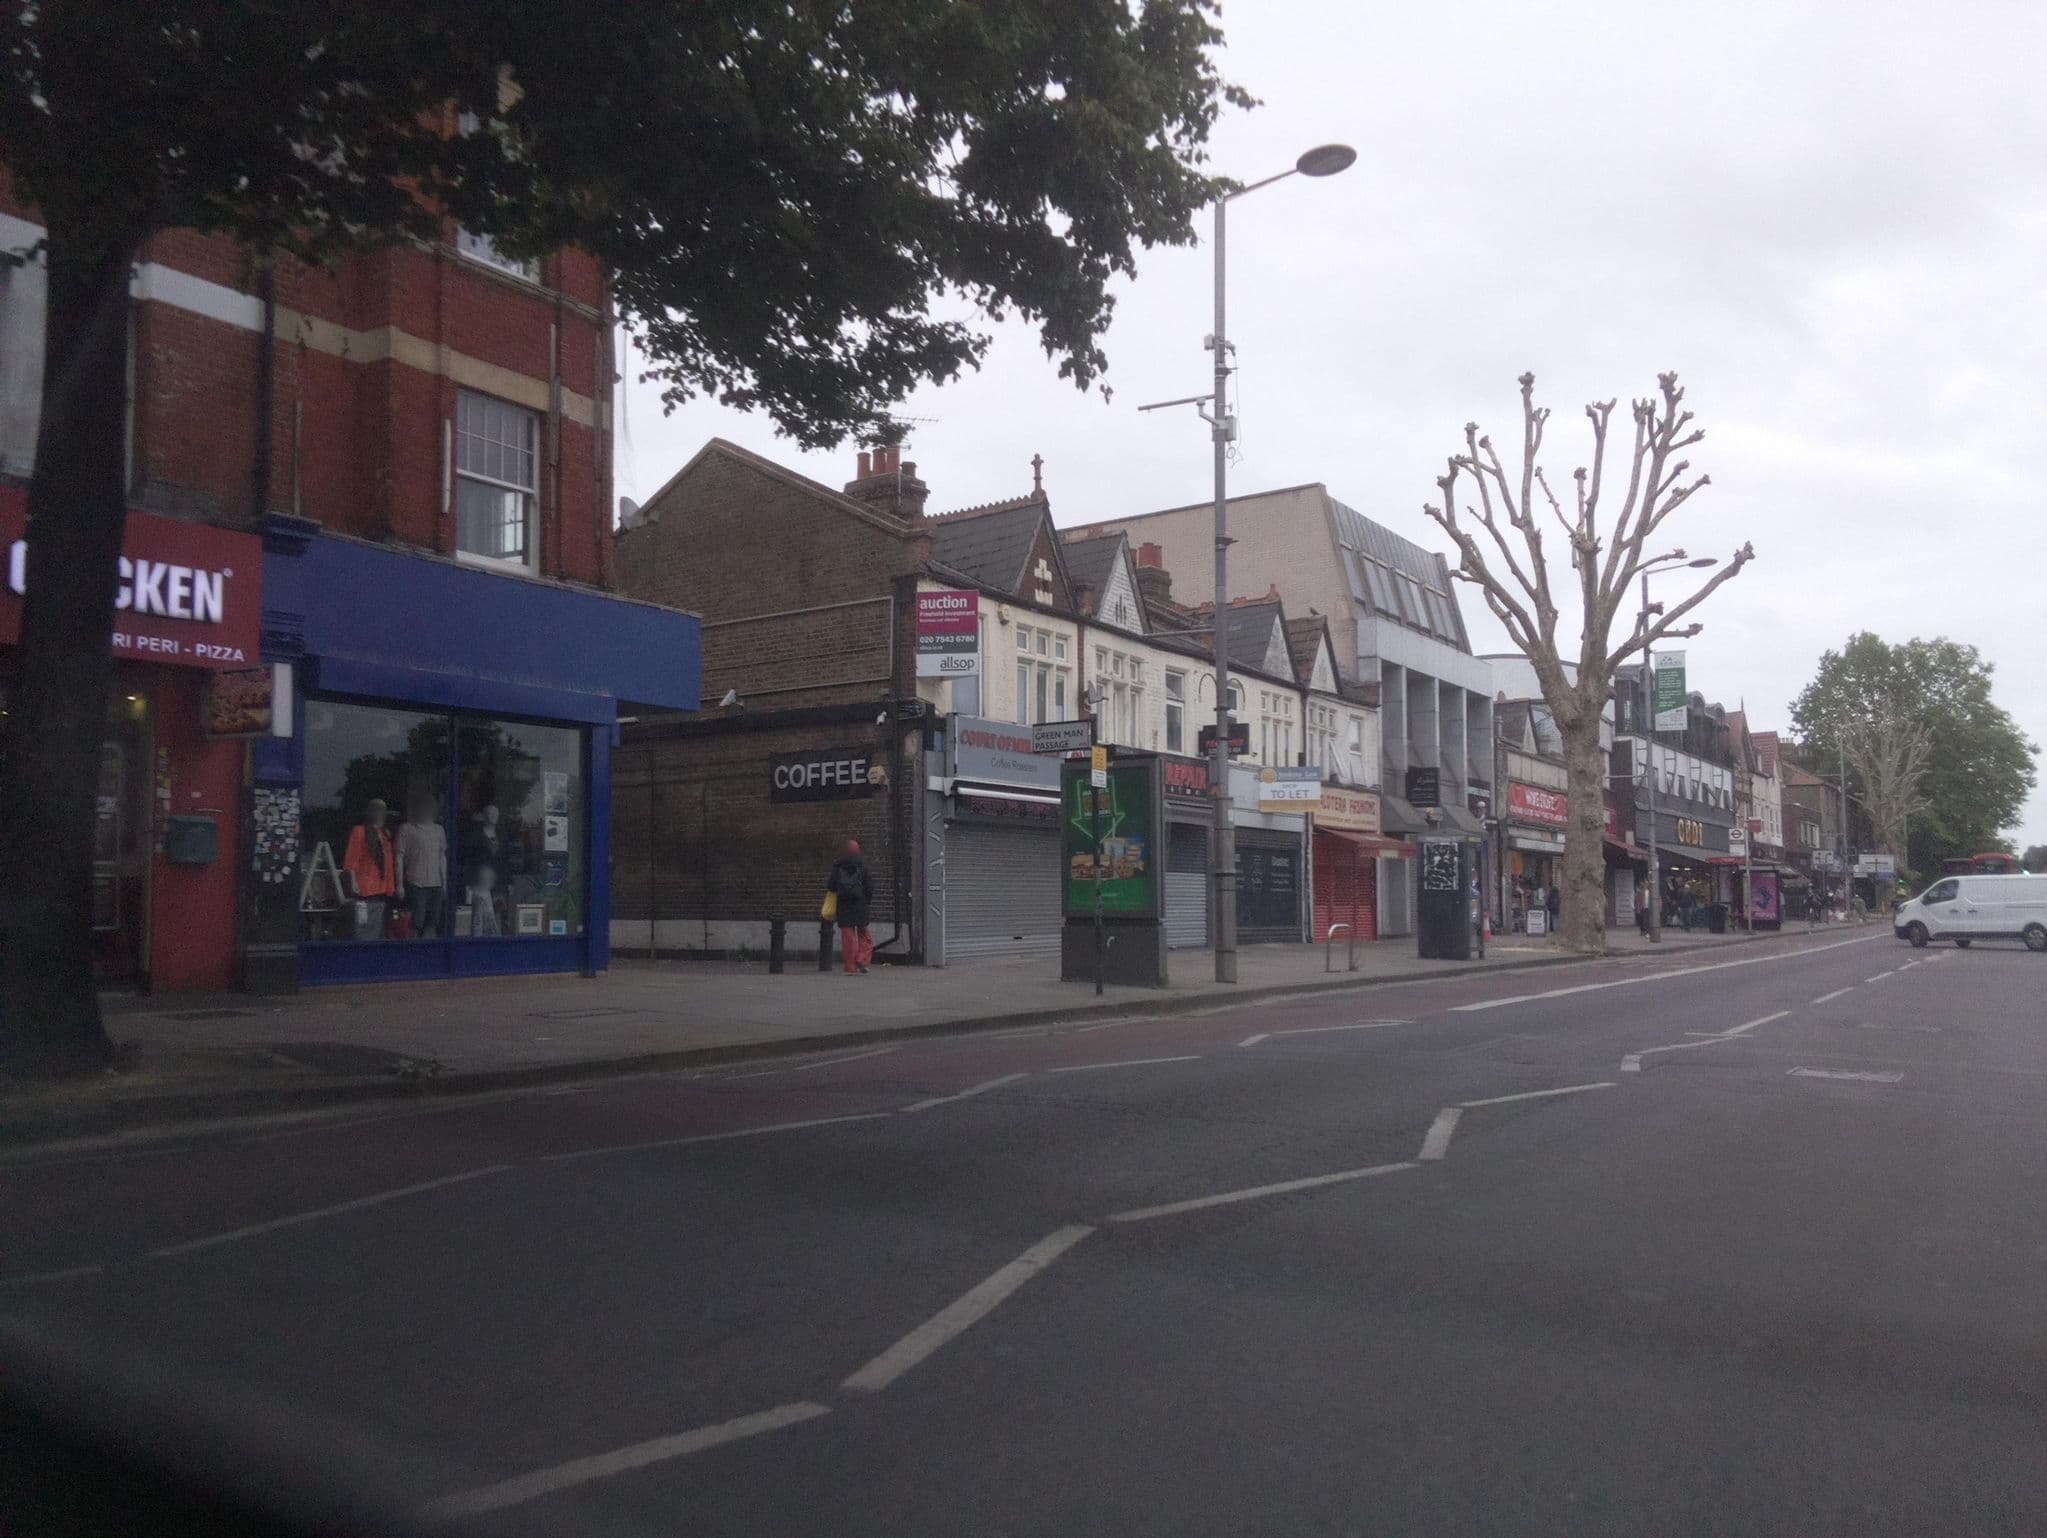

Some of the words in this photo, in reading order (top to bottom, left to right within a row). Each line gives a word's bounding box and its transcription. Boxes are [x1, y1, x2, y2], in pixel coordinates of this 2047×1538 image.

[920, 595, 968, 609] auction
[919, 635, 934, 643] 020
[137, 636, 179, 654] PERI
[196, 643, 245, 662] PIZZA
[940, 656, 974, 669] allsop
[1035, 731, 1061, 740] GREEN
[1063, 729, 1084, 738] MAN
[1035, 741, 1069, 750] PASSAGE
[775, 759, 867, 789] COFFEE
[1271, 790, 1285, 799] TO
[1289, 790, 1309, 798] LET
